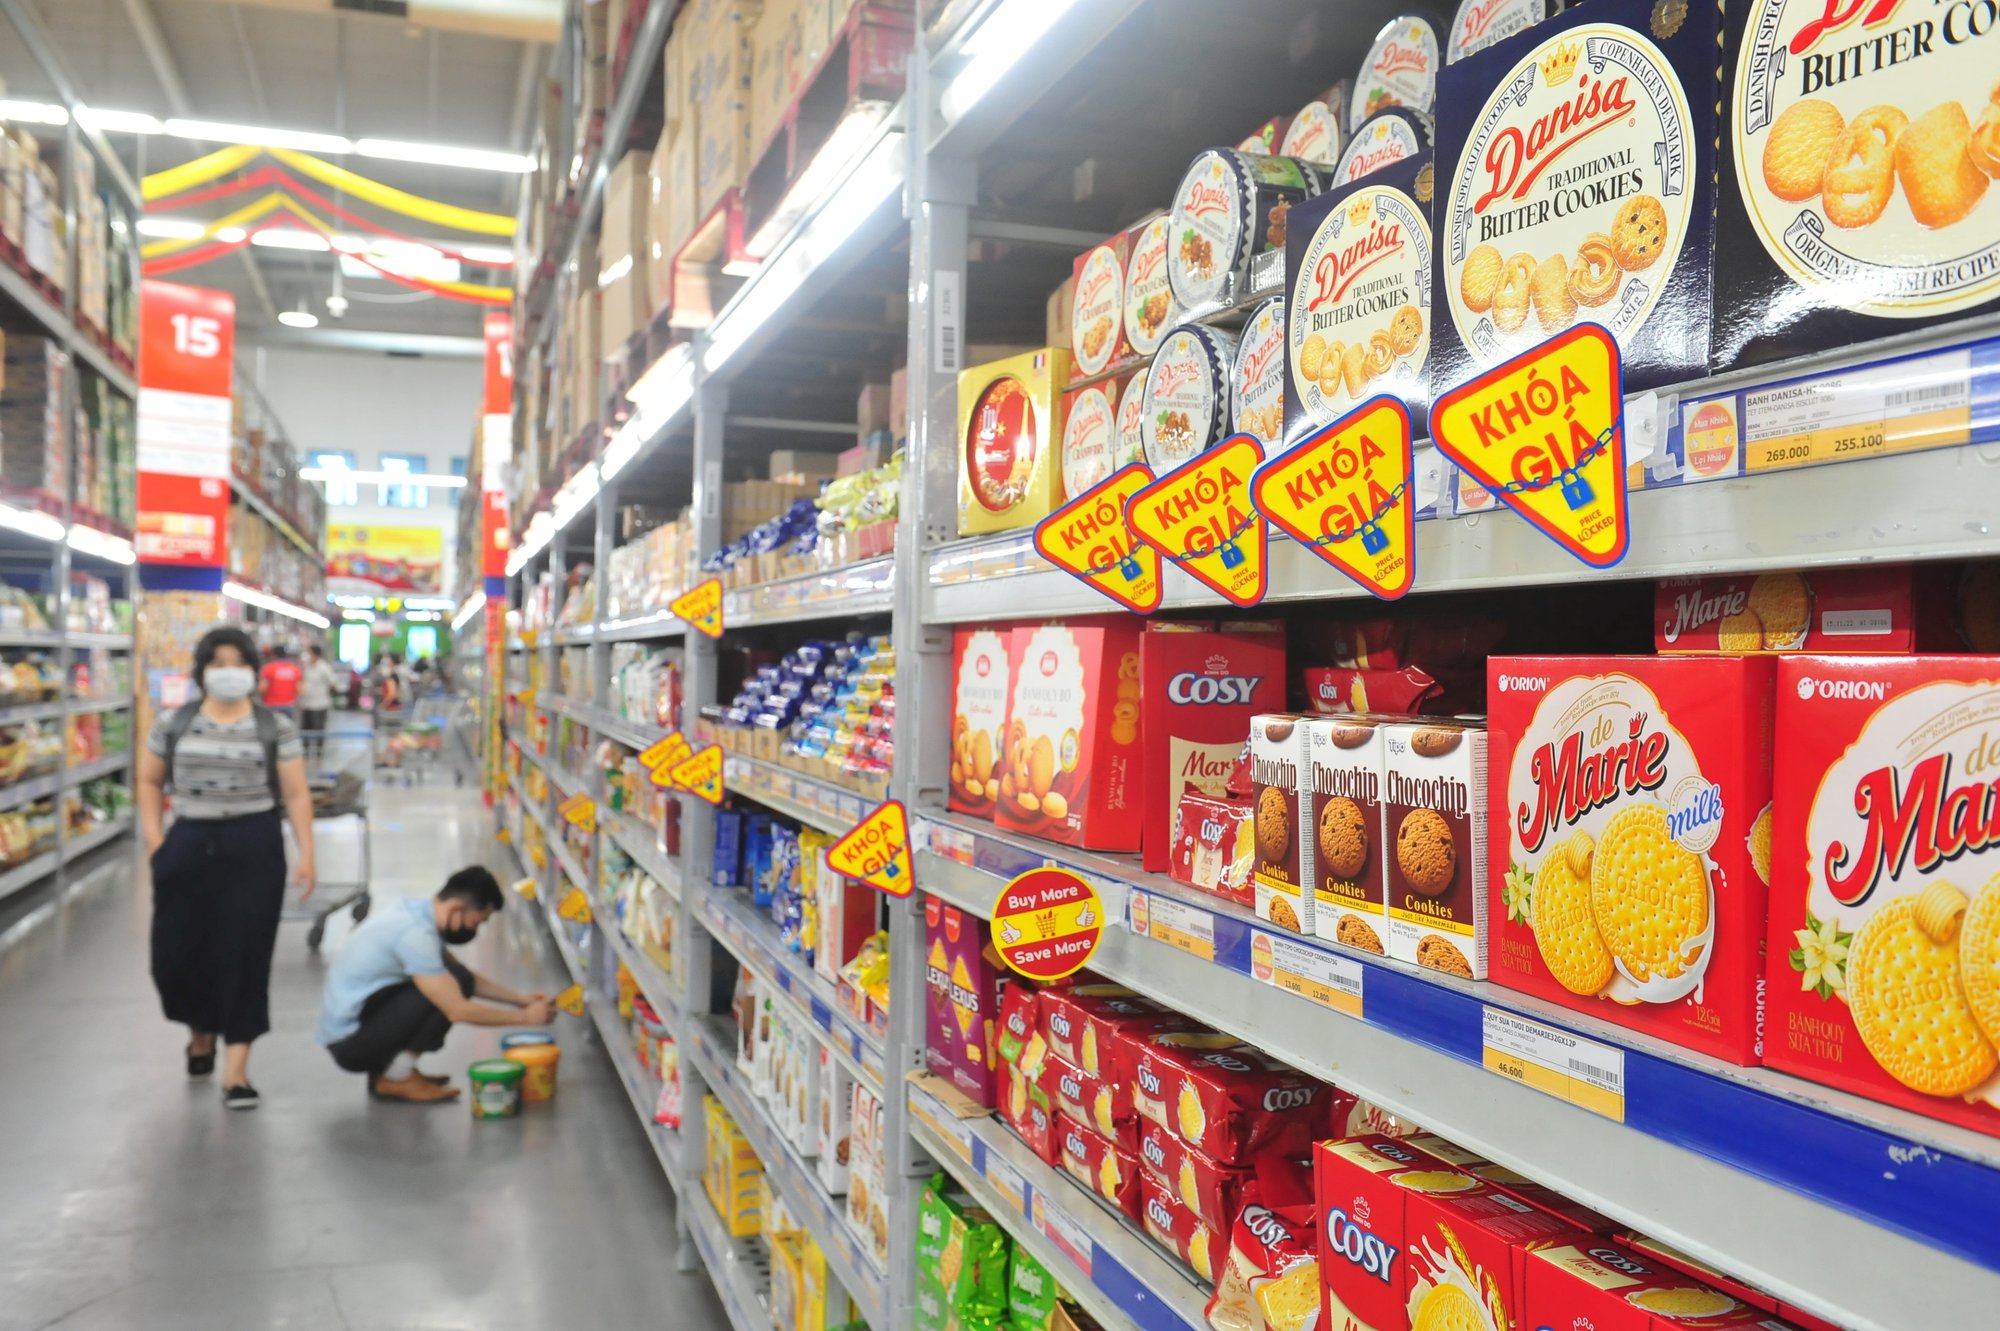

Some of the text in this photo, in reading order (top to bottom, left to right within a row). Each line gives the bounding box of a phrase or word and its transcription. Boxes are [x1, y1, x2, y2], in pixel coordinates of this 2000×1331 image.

[1800, 19, 1934, 97] BUTTER
[1750, 42, 1770, 113] DANISH
[1599, 41, 1683, 178] COPENHAGEN DENMARK
[1474, 73, 1637, 215] Danisa
[1458, 133, 1487, 203] SPECIALITY
[1547, 148, 1635, 192] TRADITIONAL
[1480, 167, 1644, 243] BUTTER COOKIES
[1453, 204, 1464, 251] DANISH
[1309, 219, 1405, 312] Danisa
[1352, 272, 1405, 299] TRADITIONAL
[1312, 287, 1409, 333] BUTTER COOKIES
[171, 313, 221, 358] 15
[1242, 326, 1285, 394] Danis
[1469, 364, 1592, 449] KHÓA
[1747, 394, 1769, 407] BANH
[1510, 404, 1608, 493] GIÁ
[1766, 433, 1883, 462] 269.000 255.100
[1284, 433, 1387, 511] KHÓA
[1153, 465, 1242, 530] KHÓA
[1319, 468, 1401, 545] GIÁ
[1059, 490, 1128, 552] KHÓA
[1183, 494, 1256, 560] GIÁ
[1577, 515, 1616, 543] LOCKED
[1579, 508, 1603, 527] PRICE
[1232, 567, 1250, 582] PRICE
[1373, 557, 1405, 583] LOCKED
[1375, 553, 1395, 569] PRICE
[1230, 571, 1259, 593] LOCKED
[1664, 586, 1747, 644] Marie
[1168, 671, 1263, 706] COSY
[1319, 682, 1338, 699] COSY
[1510, 676, 1548, 692] ORION
[1818, 679, 1885, 700] ORION
[1313, 732, 1326, 747] Tipo
[1388, 739, 1405, 755] Tipo
[1590, 714, 1614, 749] de
[1182, 750, 1232, 778] Mar
[1252, 752, 1297, 796] Chocochip
[1312, 760, 1379, 806] Chocochip
[1387, 769, 1468, 819] Chocochip
[1517, 728, 1669, 854] Marie
[1666, 784, 1723, 842] milk
[843, 820, 893, 864] KHÓA
[863, 836, 903, 876] GIÁ
[1261, 860, 1289, 881] Cookies
[1008, 885, 1079, 910] Buy More
[1326, 877, 1366, 900] Cookies
[1405, 894, 1454, 919] Cookies
[1414, 913, 1425, 922] like
[1426, 916, 1457, 931] homemade
[1014, 938, 1092, 966] Save More
[950, 984, 980, 1013] LEXUS
[1007, 1012, 1027, 1036] COSY
[1050, 1012, 1072, 1038] COSY
[1498, 1016, 1510, 1026] SUA
[1510, 1019, 1525, 1032] TUOI
[1060, 1073, 1081, 1100] COSY
[1137, 1063, 1161, 1095] COSY
[1498, 1062, 1523, 1080] 46.600
[1263, 1087, 1318, 1112] COSY
[1066, 1132, 1088, 1160] COSY
[1143, 1136, 1166, 1168] COSY
[1371, 1143, 1418, 1163] COSY
[1148, 1198, 1174, 1233] COSY
[1243, 1203, 1294, 1252] COSY
[1327, 1207, 1400, 1286] COSY
[1587, 1248, 1653, 1275] COSY
